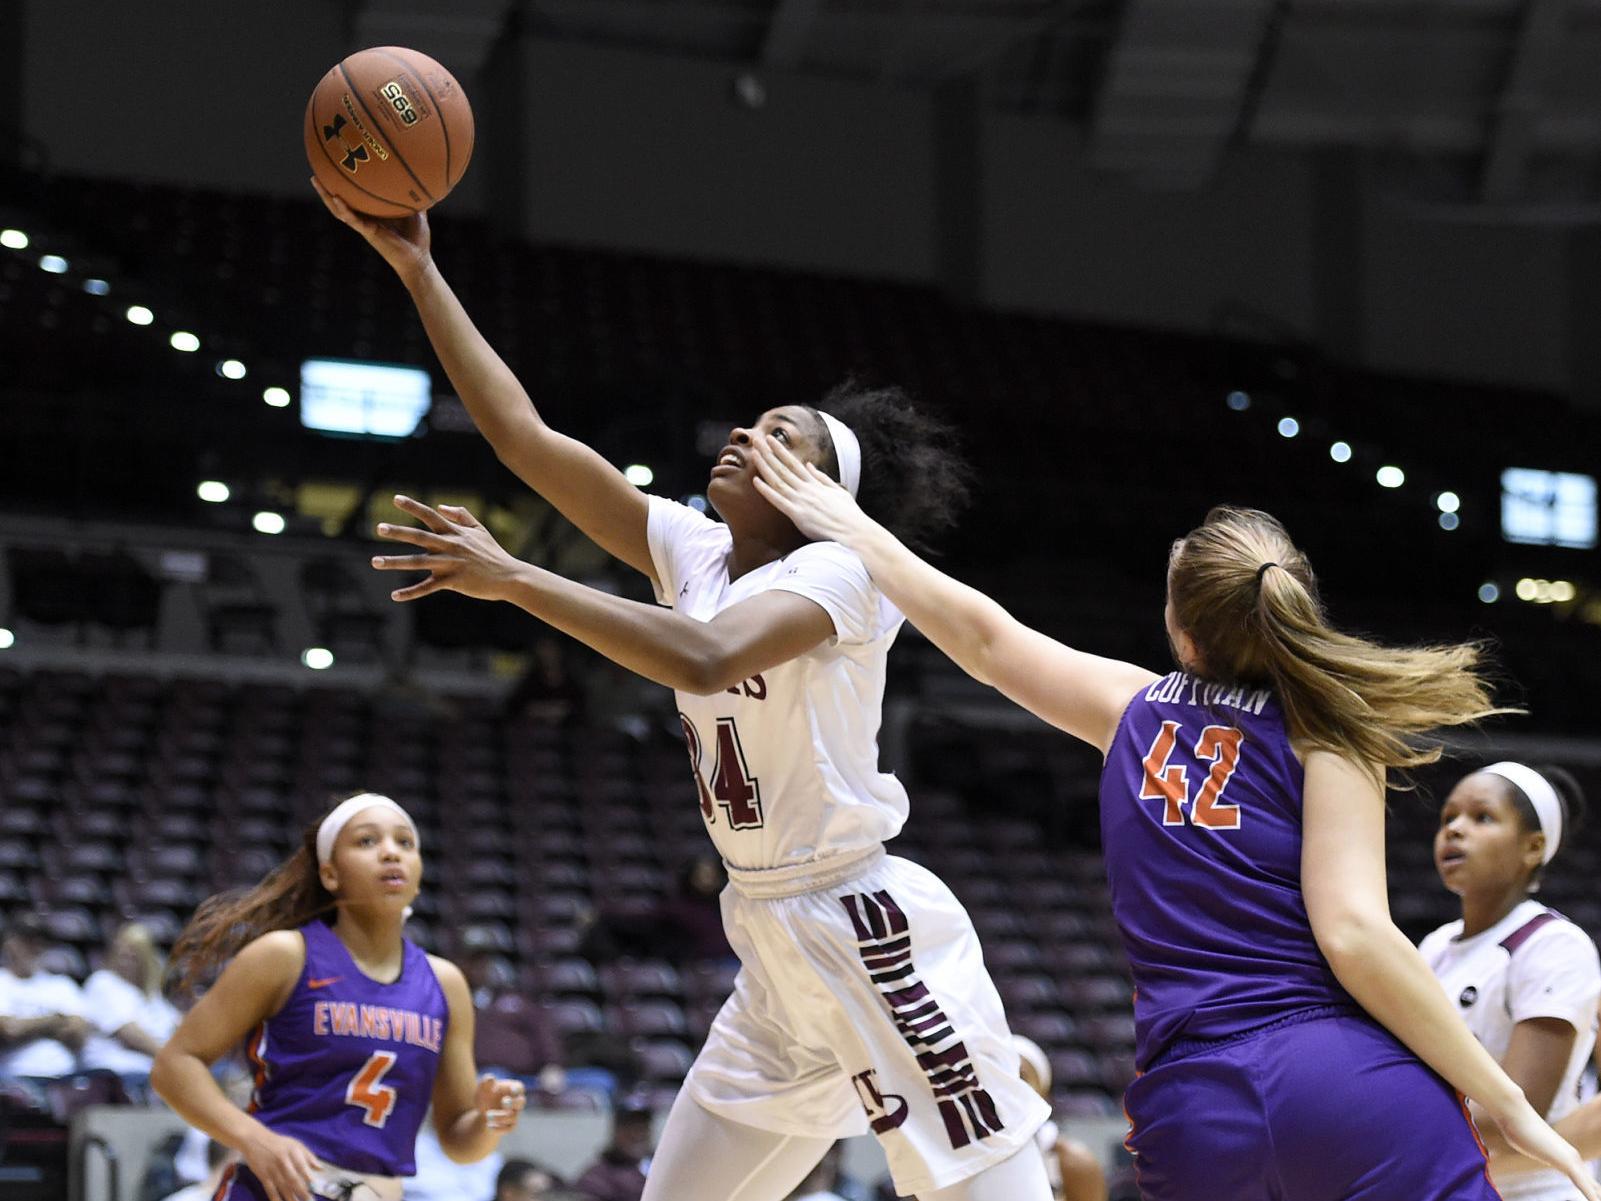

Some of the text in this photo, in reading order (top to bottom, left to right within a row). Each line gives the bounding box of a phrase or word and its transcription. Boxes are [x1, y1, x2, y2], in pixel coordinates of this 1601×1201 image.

[381, 81, 418, 127] 695
[1139, 720, 1244, 830] 42
[313, 1000, 443, 1054] EVANSVILLE
[344, 1049, 398, 1129] 4
